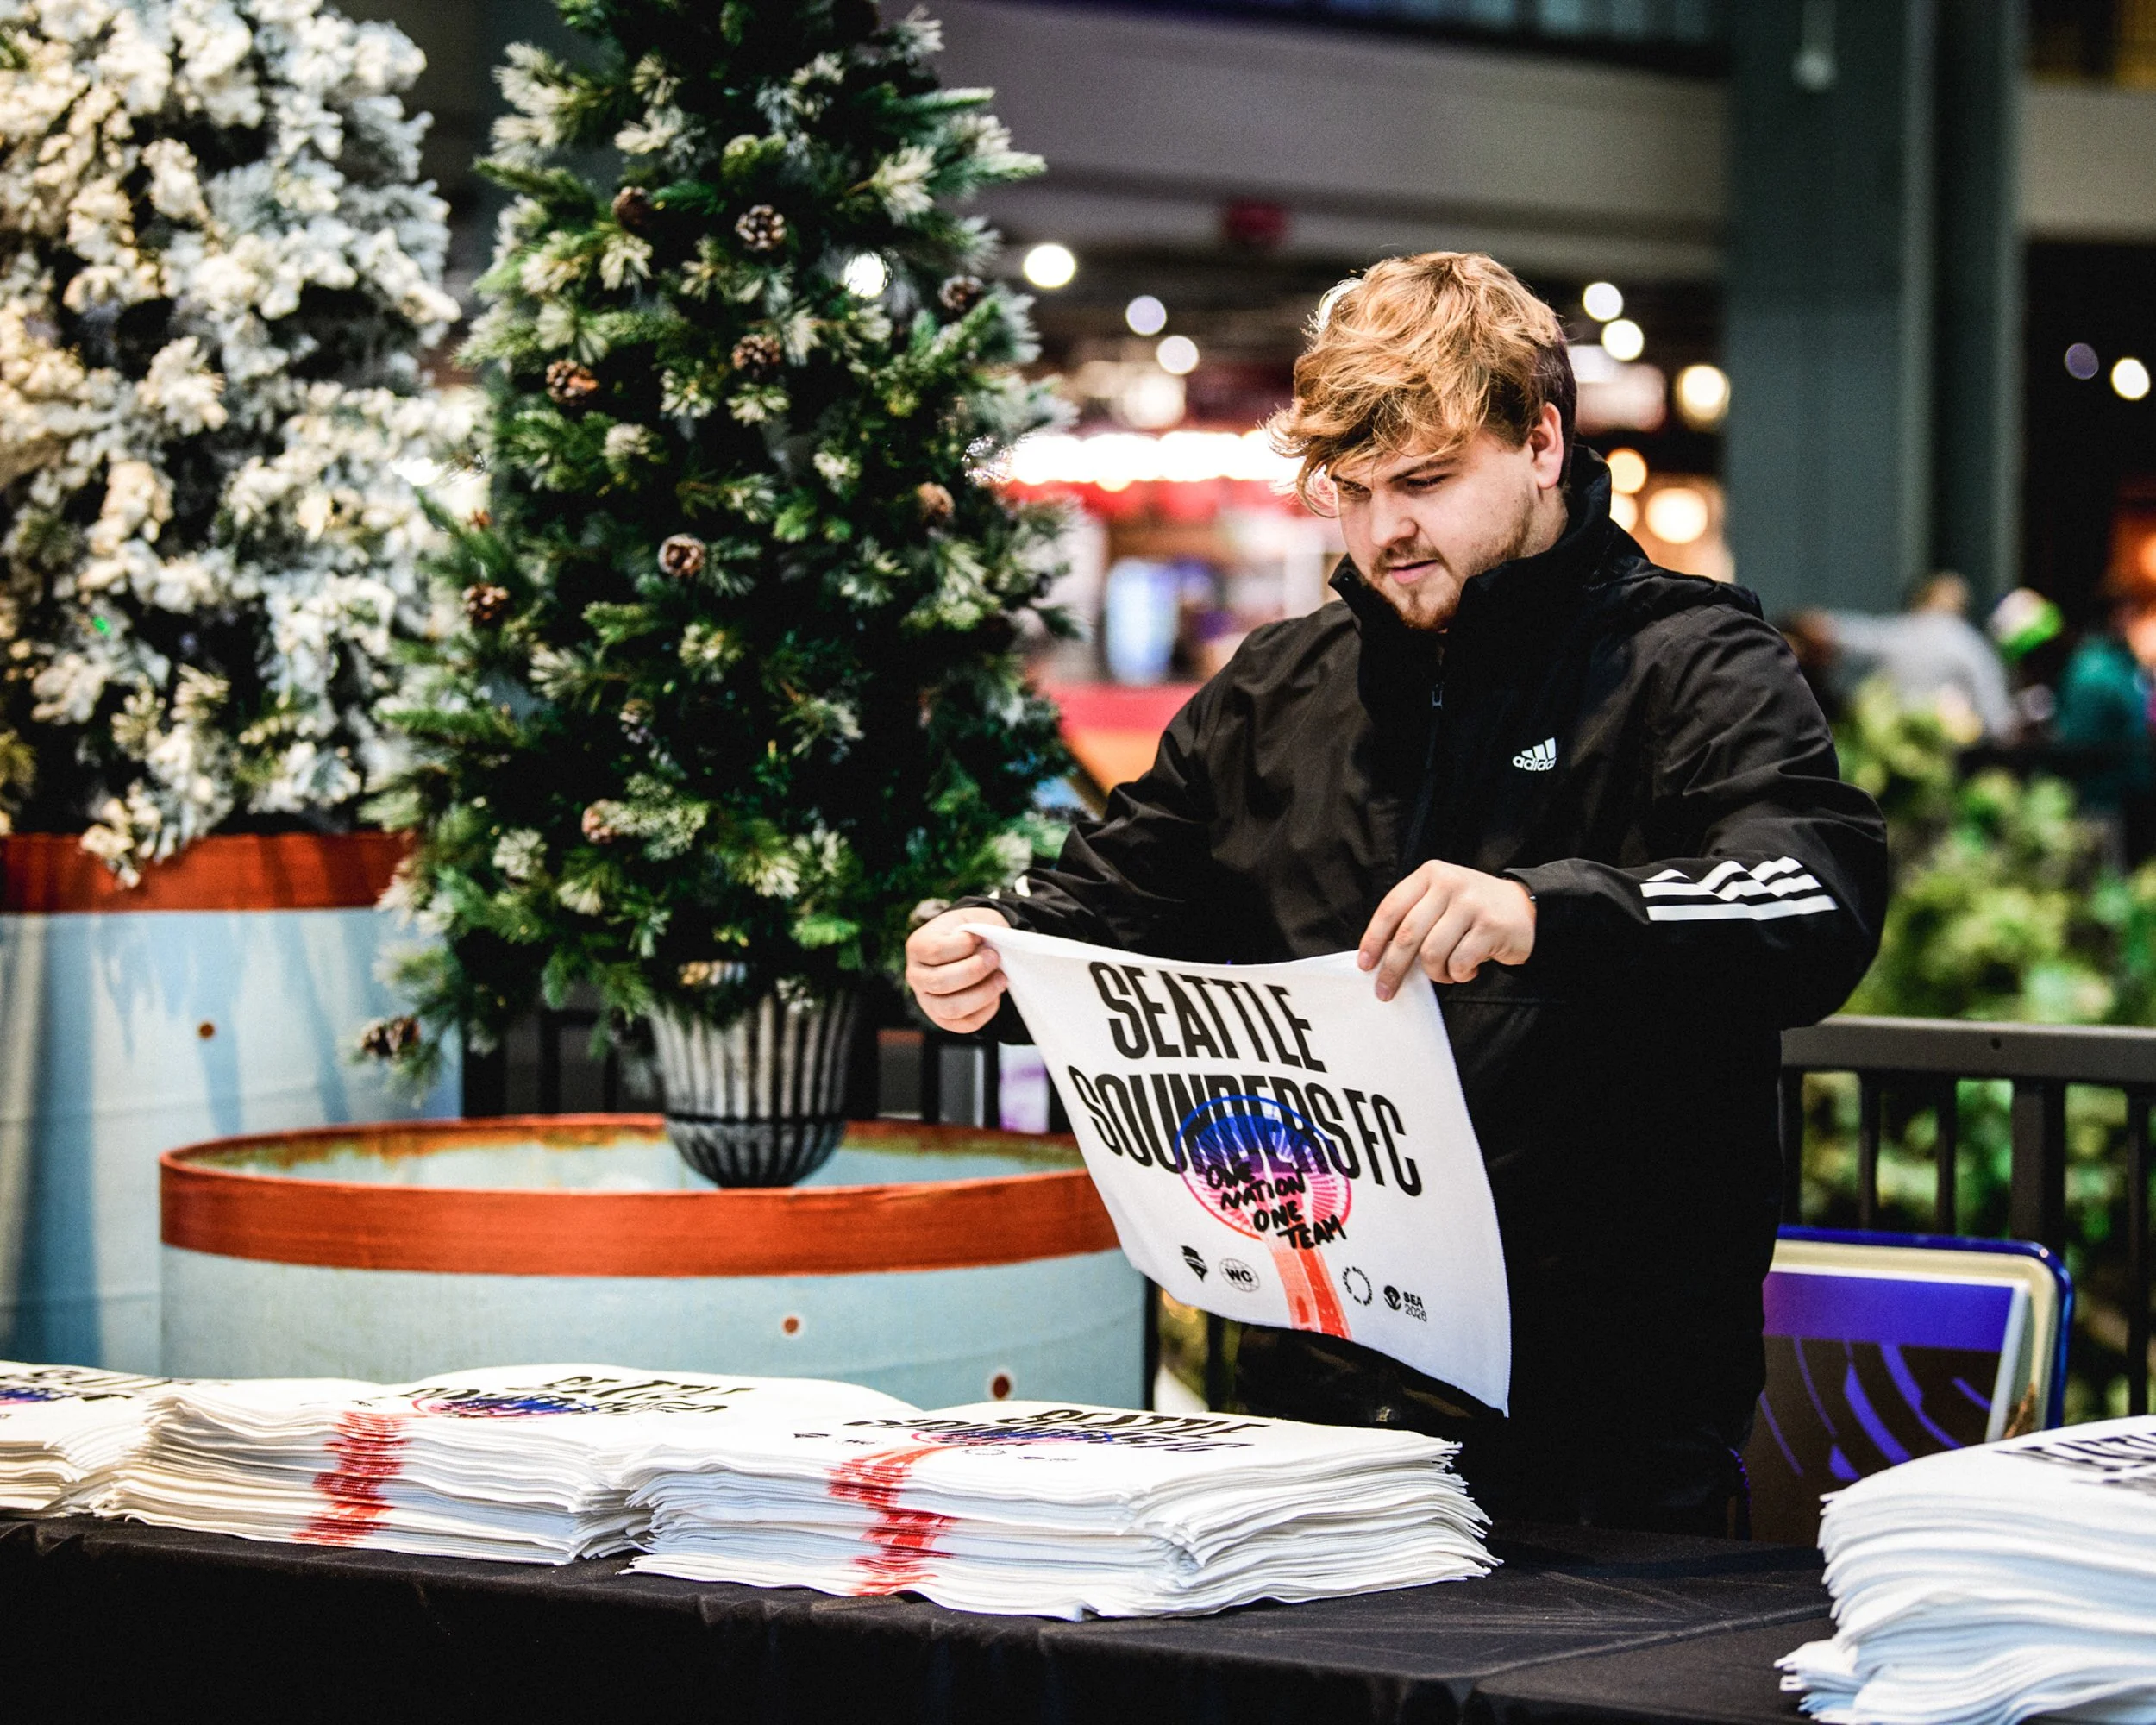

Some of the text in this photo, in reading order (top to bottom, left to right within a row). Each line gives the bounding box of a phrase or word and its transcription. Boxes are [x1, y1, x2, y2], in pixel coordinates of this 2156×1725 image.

[1088, 961, 1328, 1074] SEATTLE
[1067, 1065, 1422, 1197] SOUNDERS FC
[1206, 1158, 1256, 1189] ONE
[1220, 1168, 1306, 1211] NATION
[1253, 1200, 1302, 1232] ONE
[1276, 1214, 1347, 1249] TEAM
[1225, 1268, 1253, 1283] WC
[1403, 1291, 1424, 1309] SEA
